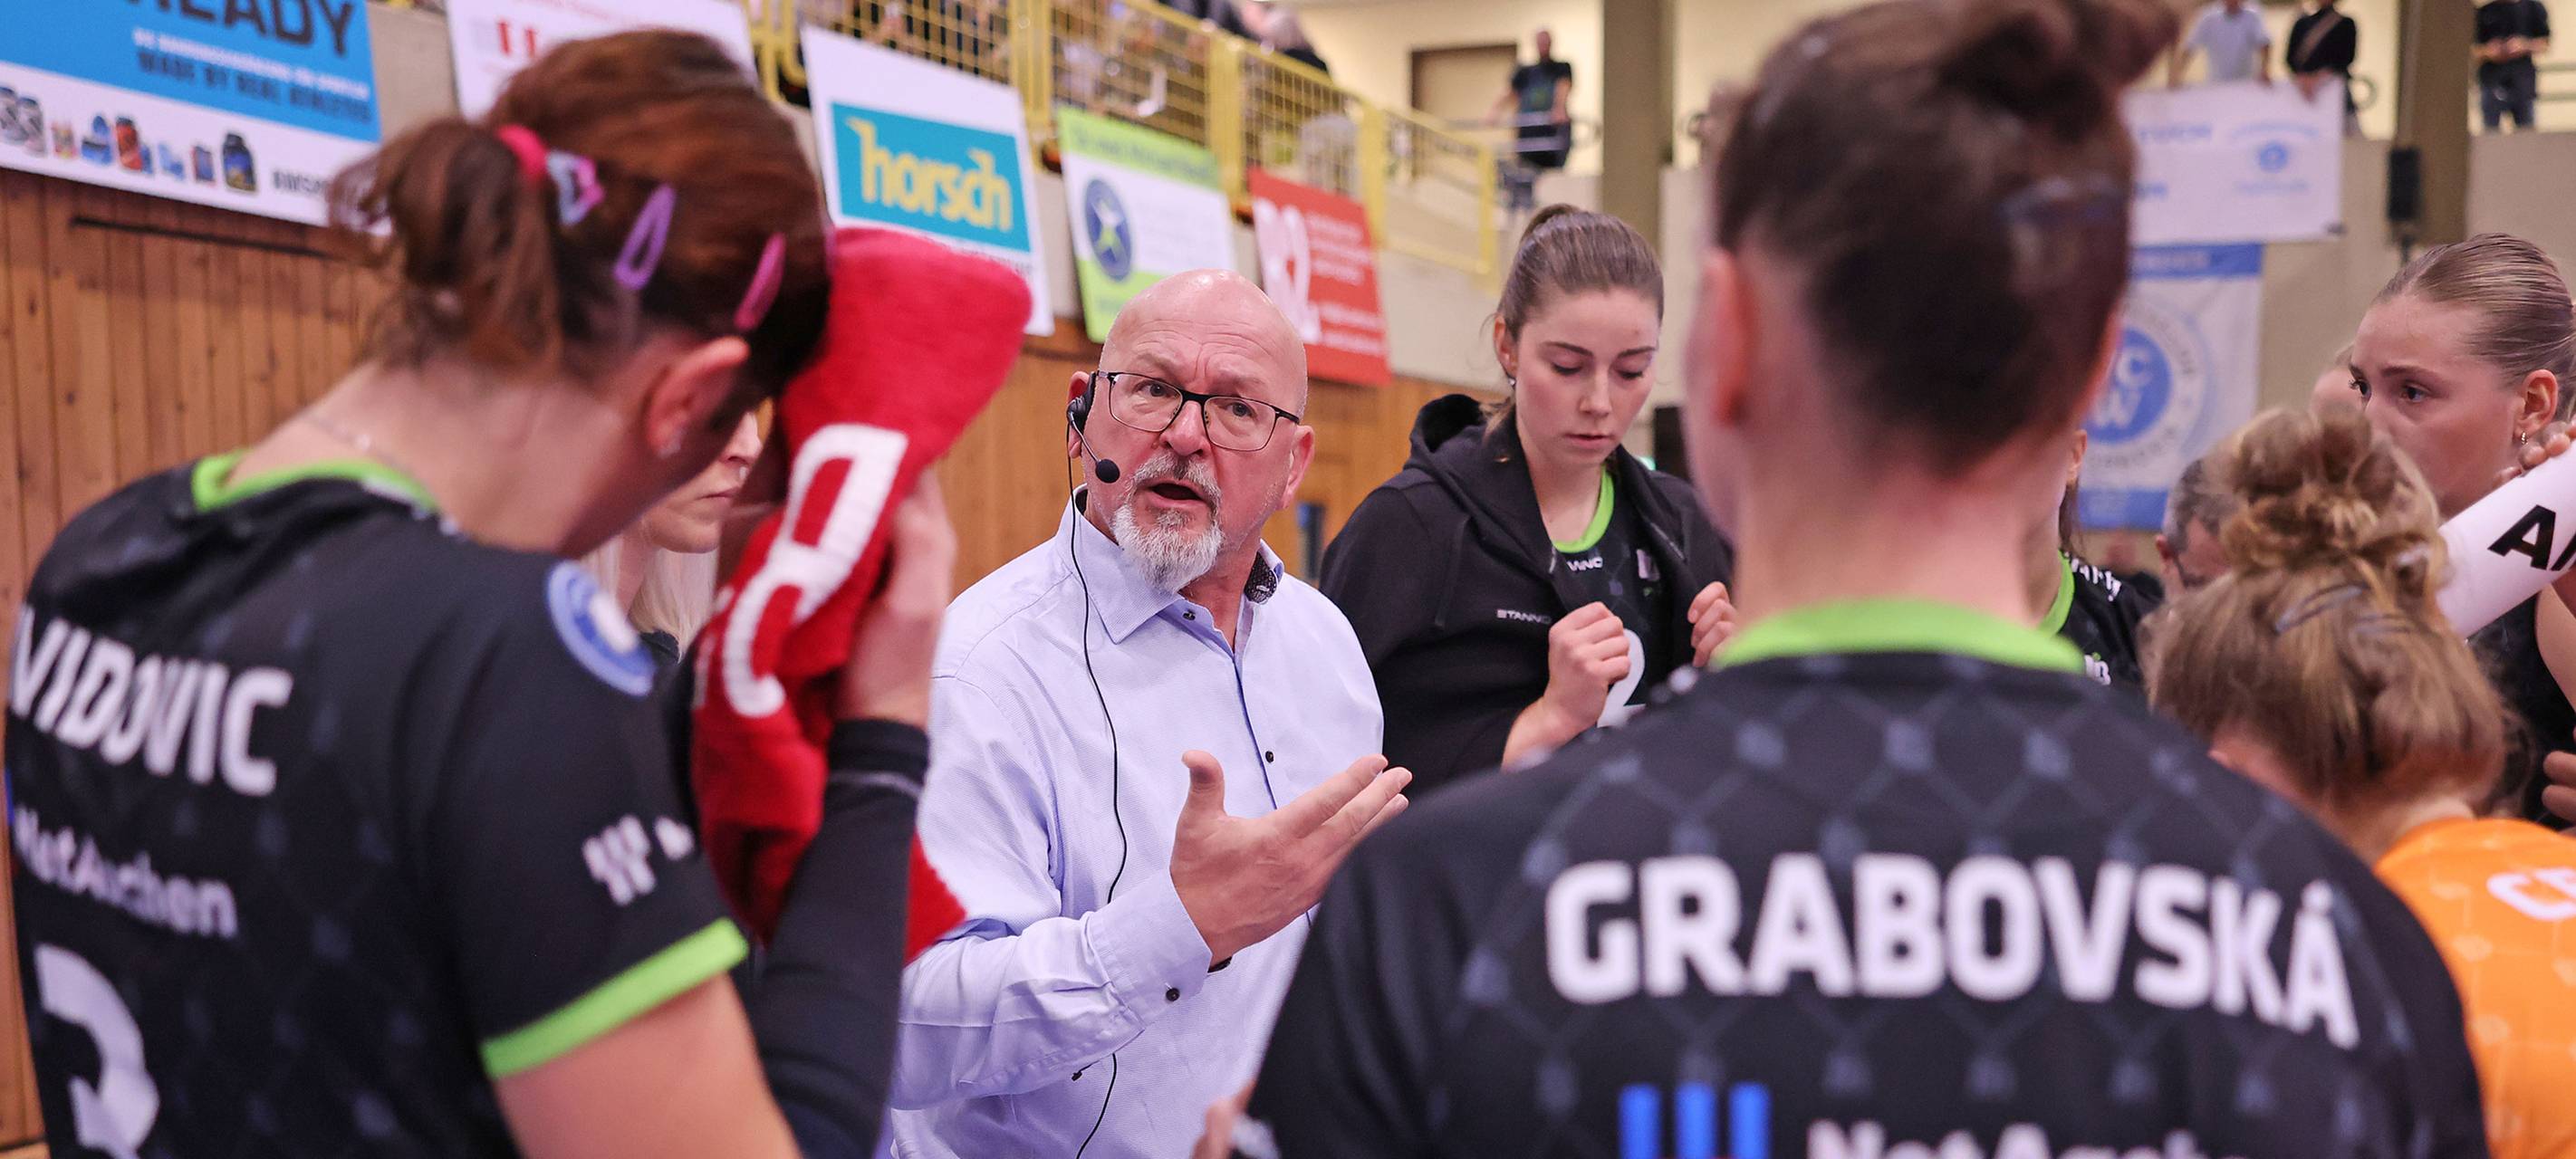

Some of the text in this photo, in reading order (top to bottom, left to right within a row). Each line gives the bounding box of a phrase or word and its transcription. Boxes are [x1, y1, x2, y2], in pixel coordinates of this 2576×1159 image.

[127, 0, 355, 58] ADY
[846, 116, 1014, 233] horsch
[1543, 852, 2359, 1050] GRABOVSKÁ
